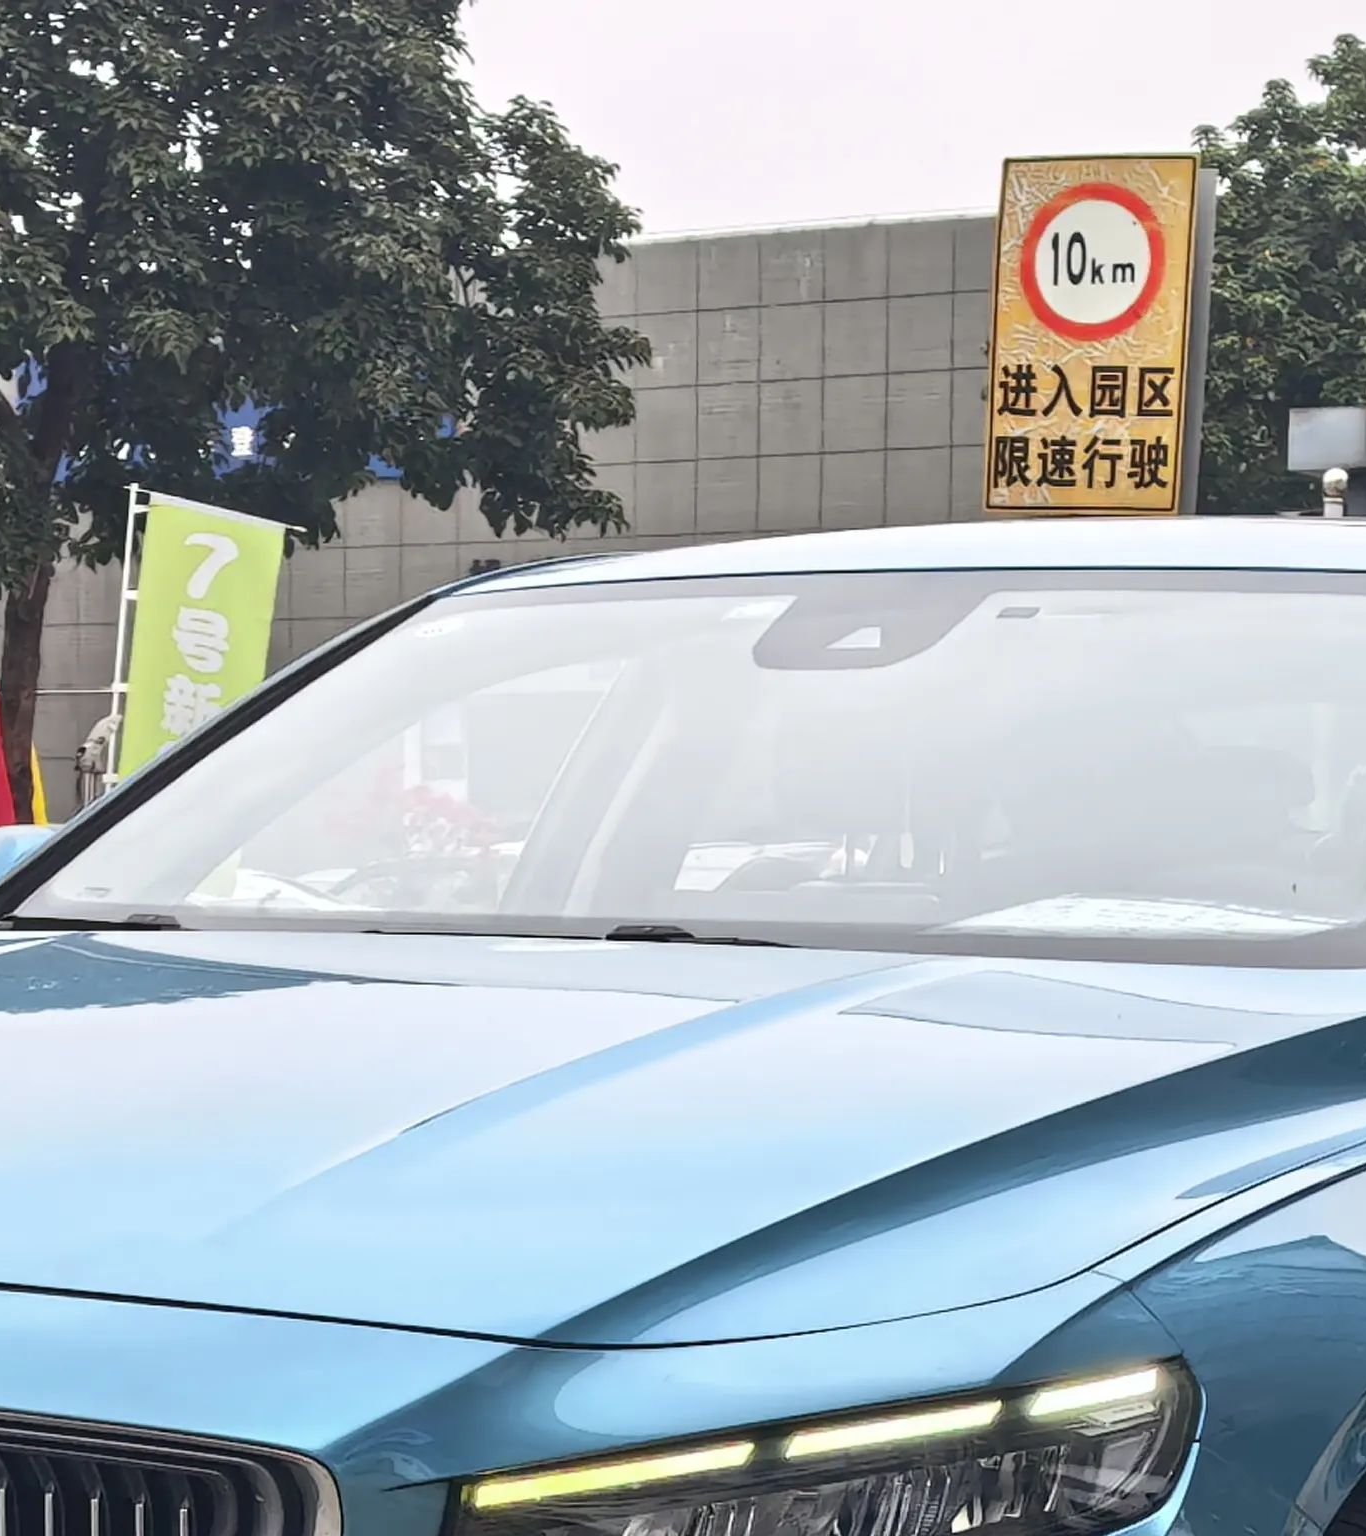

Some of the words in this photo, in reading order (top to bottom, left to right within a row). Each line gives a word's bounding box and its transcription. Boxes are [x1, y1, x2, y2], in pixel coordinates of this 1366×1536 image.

[1050, 232, 1136, 286] 10km
[996, 364, 1175, 418] 进入园区
[993, 436, 1171, 490] 限速行驶
[159, 533, 239, 750] 7号新
